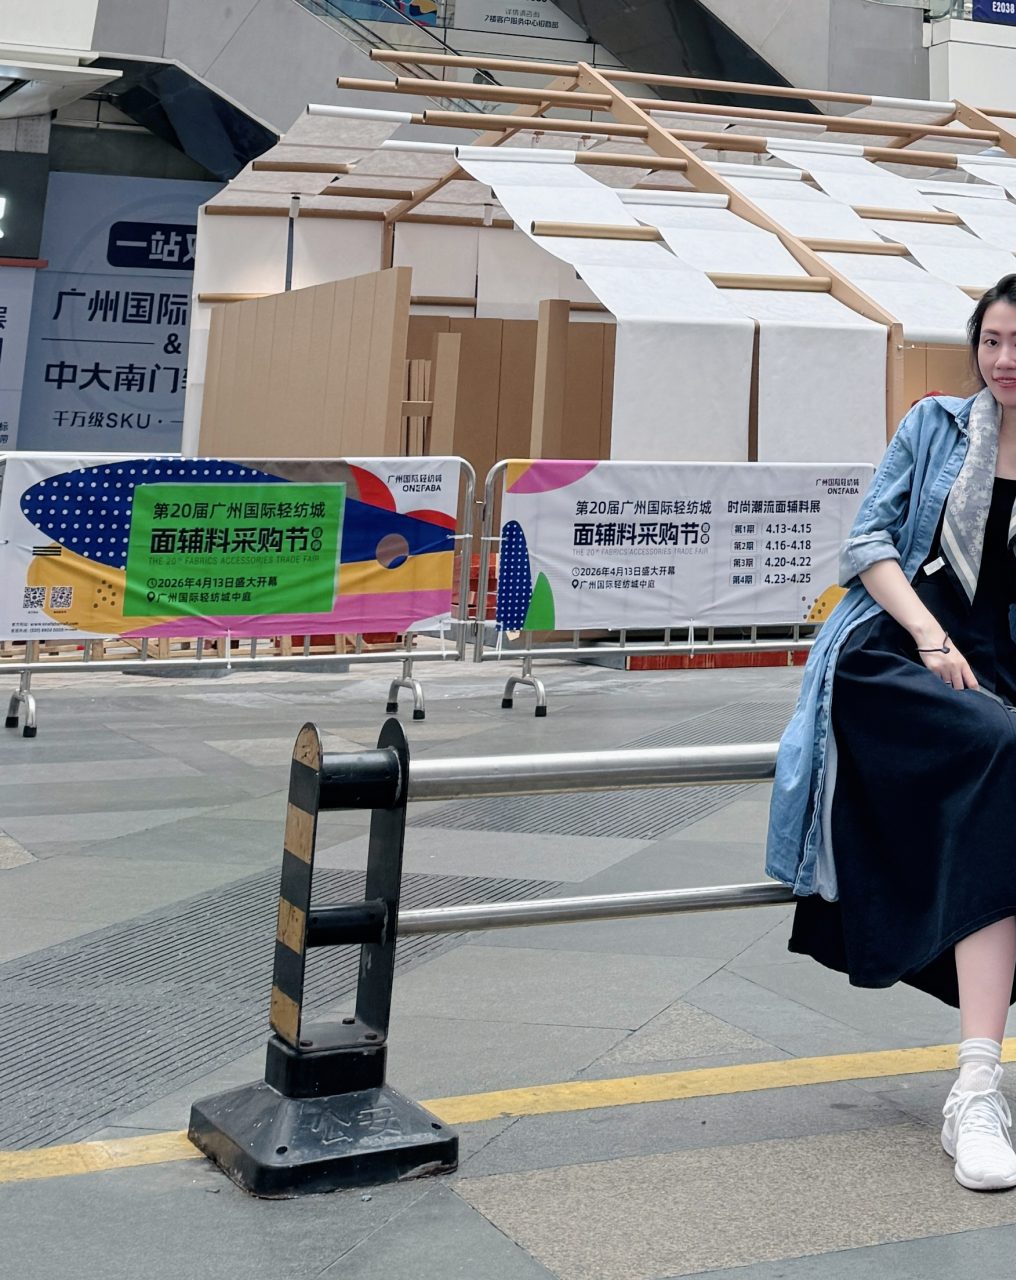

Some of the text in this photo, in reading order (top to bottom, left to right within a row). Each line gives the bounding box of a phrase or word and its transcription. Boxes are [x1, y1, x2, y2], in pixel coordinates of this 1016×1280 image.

[992, 3, 1015, 14] E2038
[53, 288, 189, 325] 广州国际
[163, 333, 182, 355] &
[44, 361, 187, 393] 中大南门
[153, 502, 326, 519] 第20届广州国际轻纺城
[576, 500, 712, 515] 第20届广州国际轻纺城
[727, 500, 821, 514] 时尚潮流面辅料展
[573, 522, 699, 546] 面辅料采购节
[734, 524, 812, 534] 第1期 4.13-4.15
[151, 527, 309, 554] 面辅料采购节
[734, 540, 811, 551] 第2期 4.16-4.18
[733, 556, 811, 568] 第3期 4.20-4.22
[581, 566, 676, 576] 2026年4月13日盛大开幕
[157, 576, 278, 588] 2026年4月13日盛大开幕
[580, 579, 655, 589] 广州国际轻纺城中庭
[732, 573, 811, 585] 第4期 4.23-4.25
[157, 591, 251, 603] 广州国际轻纺城中庭
